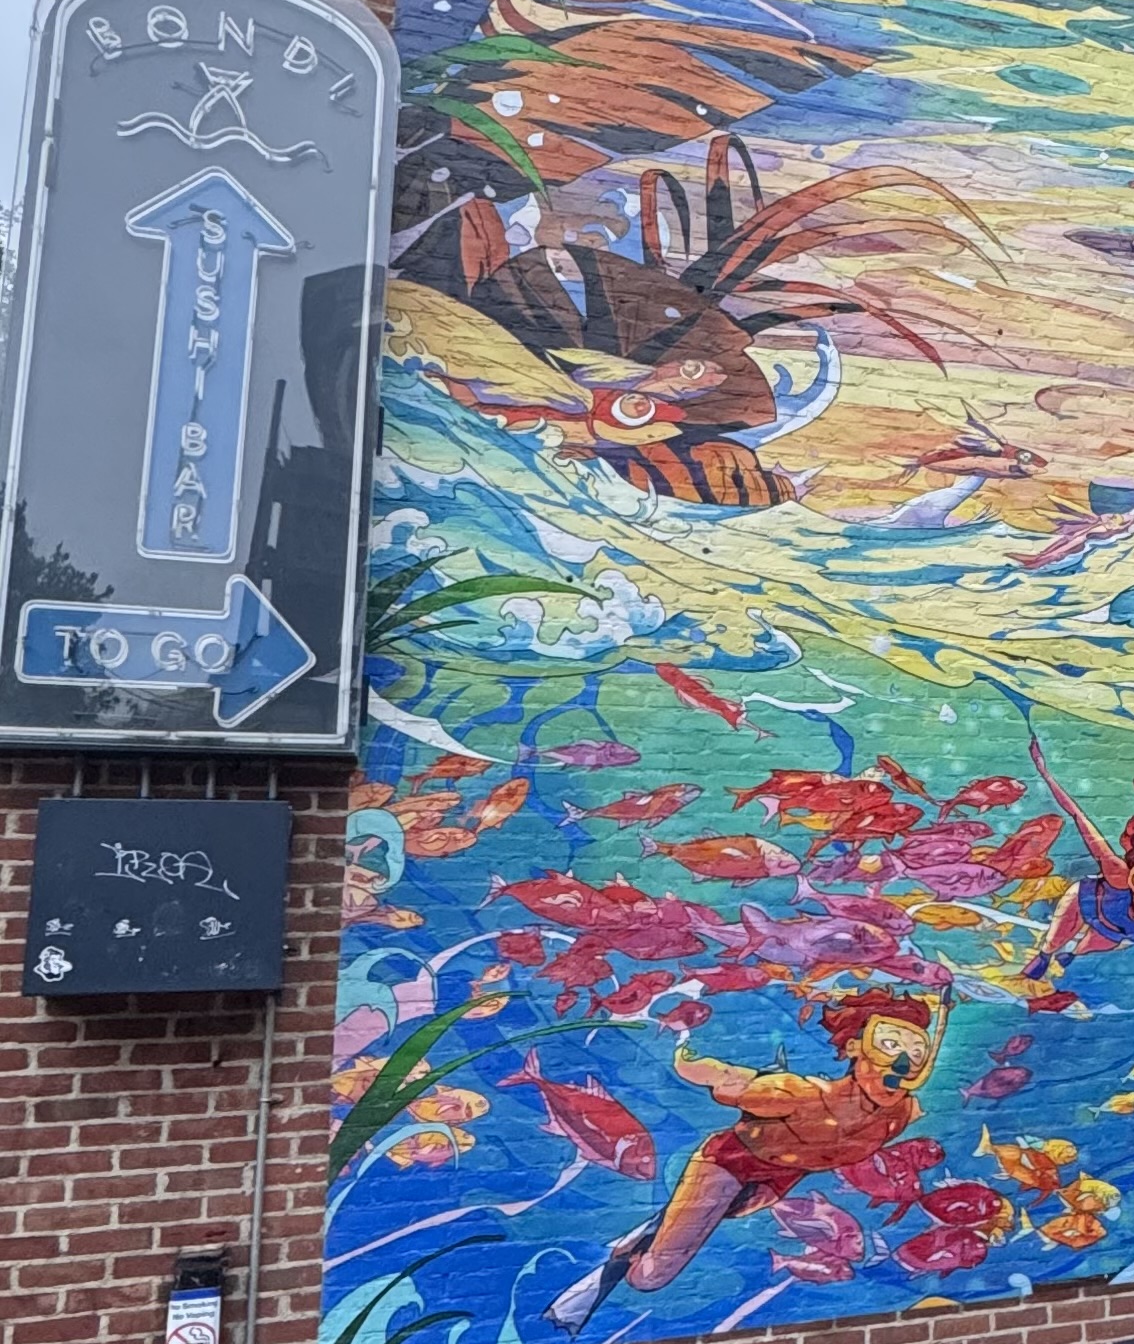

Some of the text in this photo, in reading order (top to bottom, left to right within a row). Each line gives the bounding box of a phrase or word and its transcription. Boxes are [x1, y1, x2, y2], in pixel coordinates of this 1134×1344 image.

[86, 5, 353, 101] BONDI
[172, 210, 226, 539] SUSHI BAR
[53, 625, 233, 674] TO GO
